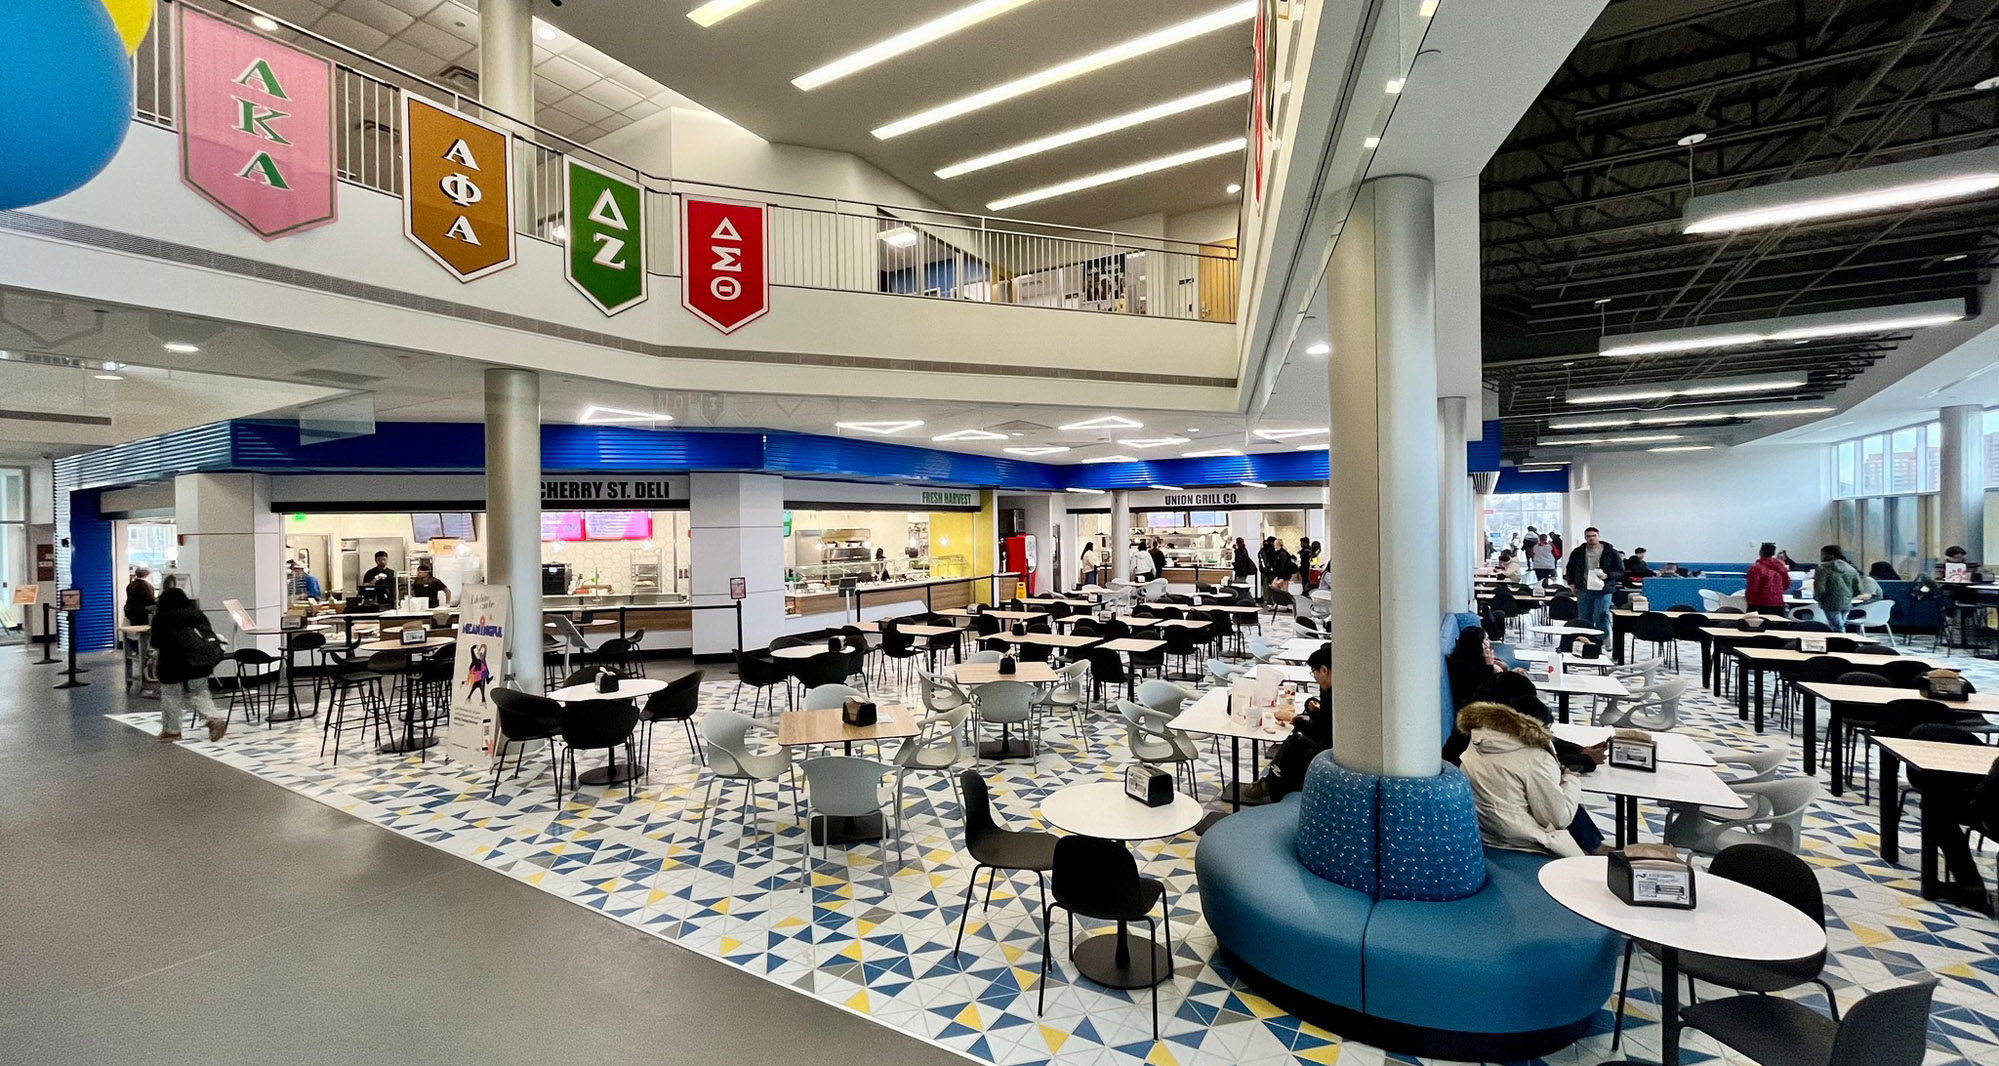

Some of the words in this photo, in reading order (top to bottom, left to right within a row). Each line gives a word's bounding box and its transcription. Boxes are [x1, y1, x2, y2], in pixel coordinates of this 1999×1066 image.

[607, 481, 631, 499] ST.
[635, 481, 669, 499] DELI
[922, 491, 944, 504] FRESH
[944, 492, 972, 505] HARVEST
[1165, 494, 1194, 506] UNION
[1195, 493, 1221, 505] GRILL
[1223, 493, 1240, 504] CO.
